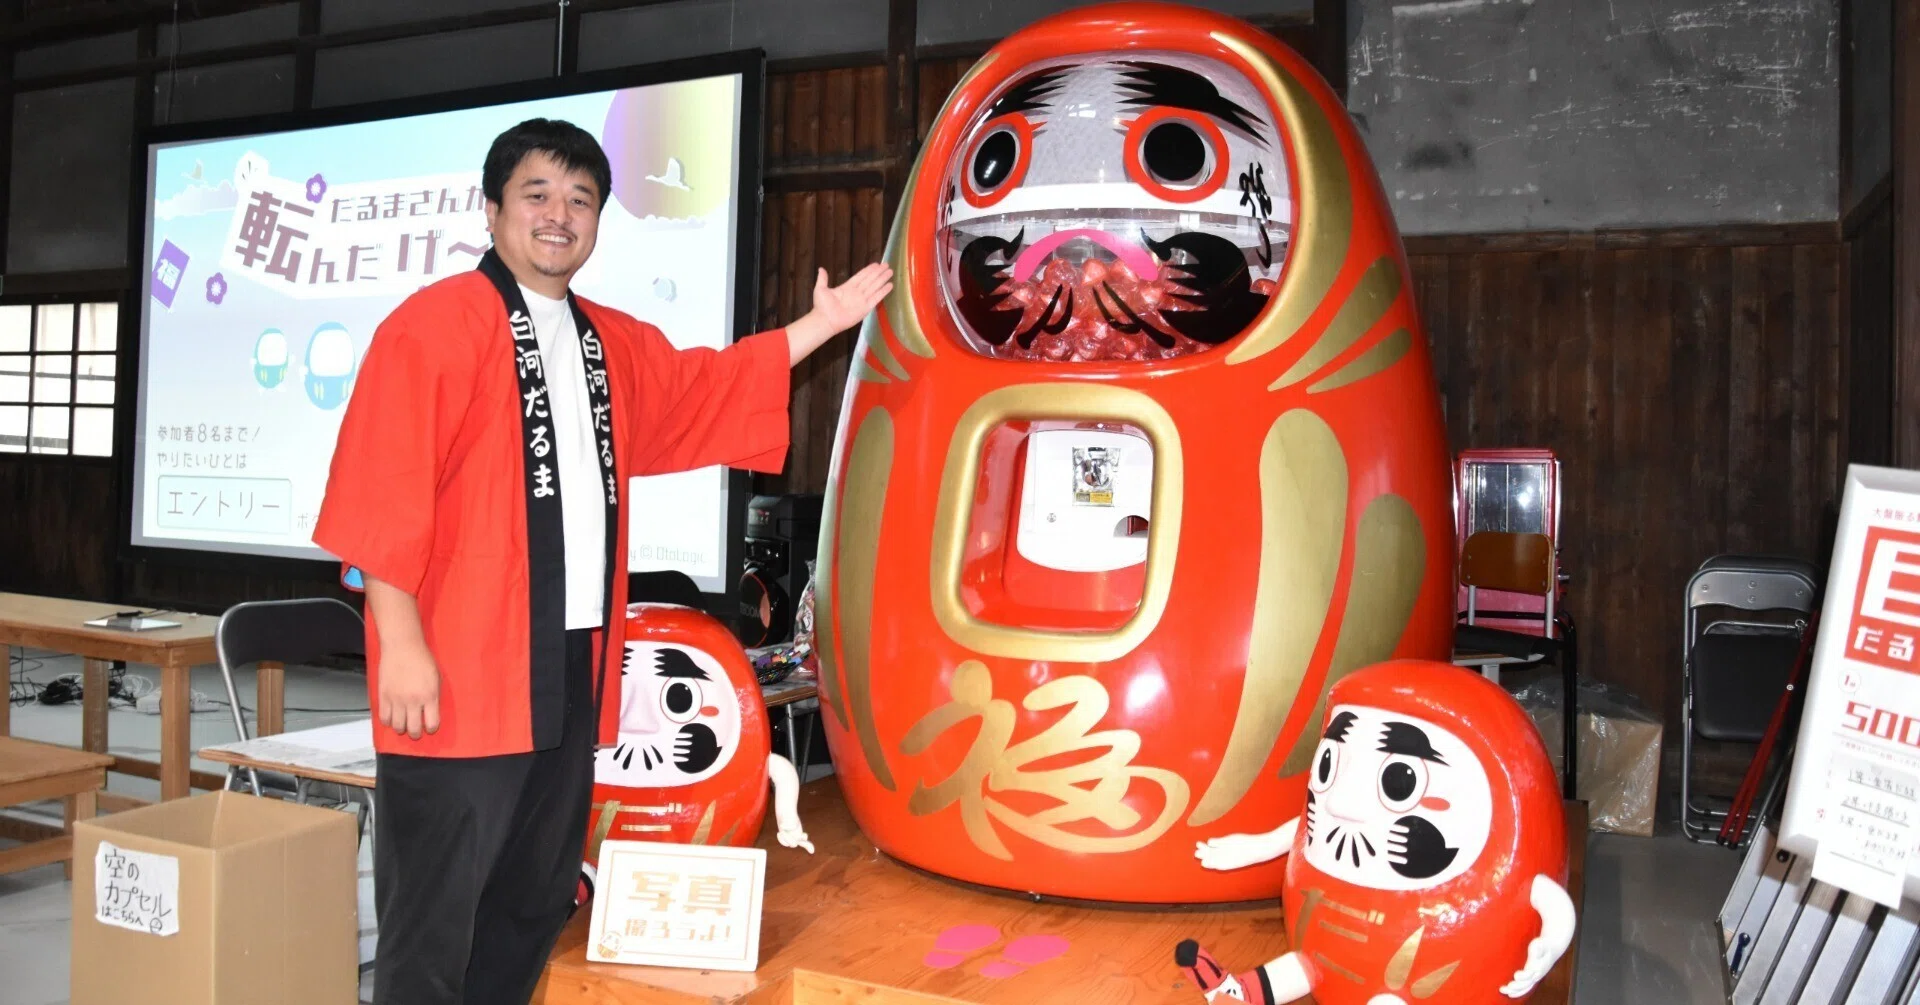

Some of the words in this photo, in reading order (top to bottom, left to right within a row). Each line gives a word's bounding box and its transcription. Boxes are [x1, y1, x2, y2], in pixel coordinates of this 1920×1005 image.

[509, 310, 555, 498] 白河だるま
[581, 329, 617, 505] 白河だるま
[157, 451, 248, 469] やりたいひとは
[167, 490, 280, 519] エントリー
[104, 848, 140, 881] 空の
[104, 880, 172, 917] カプセル
[627, 870, 737, 916] 写真
[101, 905, 144, 927] はこちらへ
